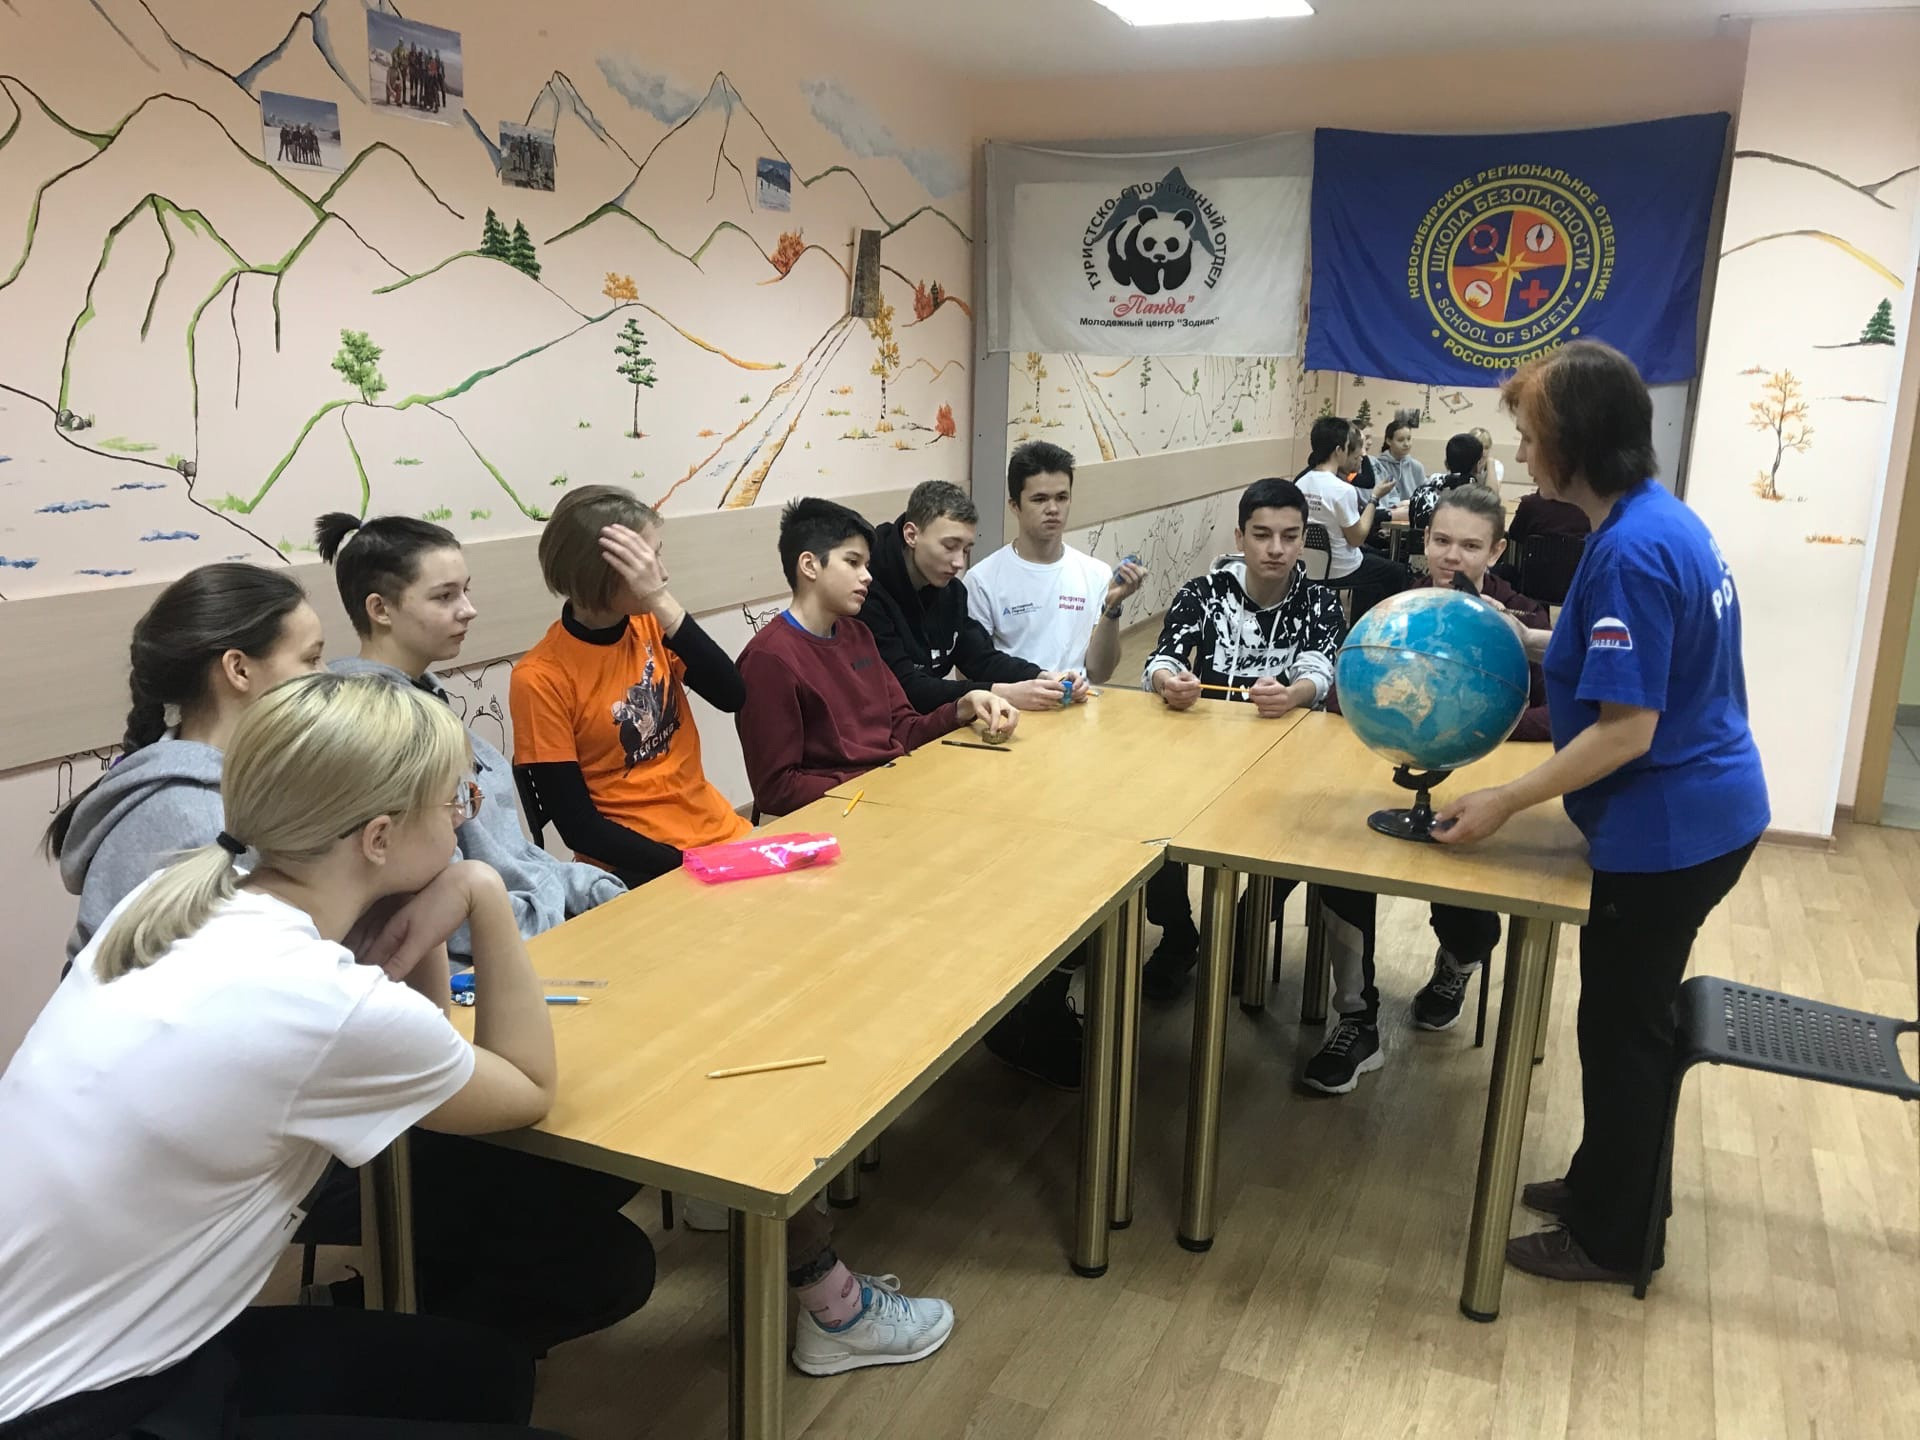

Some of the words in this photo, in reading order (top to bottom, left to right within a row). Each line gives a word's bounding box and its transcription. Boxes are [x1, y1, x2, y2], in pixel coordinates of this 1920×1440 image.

[1082, 182, 1227, 290] ТУРИСТСКО-СПОРТИВНЫЙ
[1204, 232, 1227, 289] ОТДЕЛ
[1408, 178, 1474, 299] НОВОСИБИРСКОЕ
[1477, 164, 1599, 205] РЕГИОНАЛЬНОЕ
[1592, 205, 1616, 301] ОТДЕЛЕНИЕ
[1431, 208, 1473, 272] ШКОЛА
[1474, 187, 1590, 270] БЕЗОПАСНОСТИ
[1080, 317, 1143, 328] Молодежный
[1146, 319, 1175, 329] центр
[1438, 297, 1489, 343] SCHOOL
[1494, 331, 1515, 345] OF
[1520, 295, 1575, 340] SAFETY
